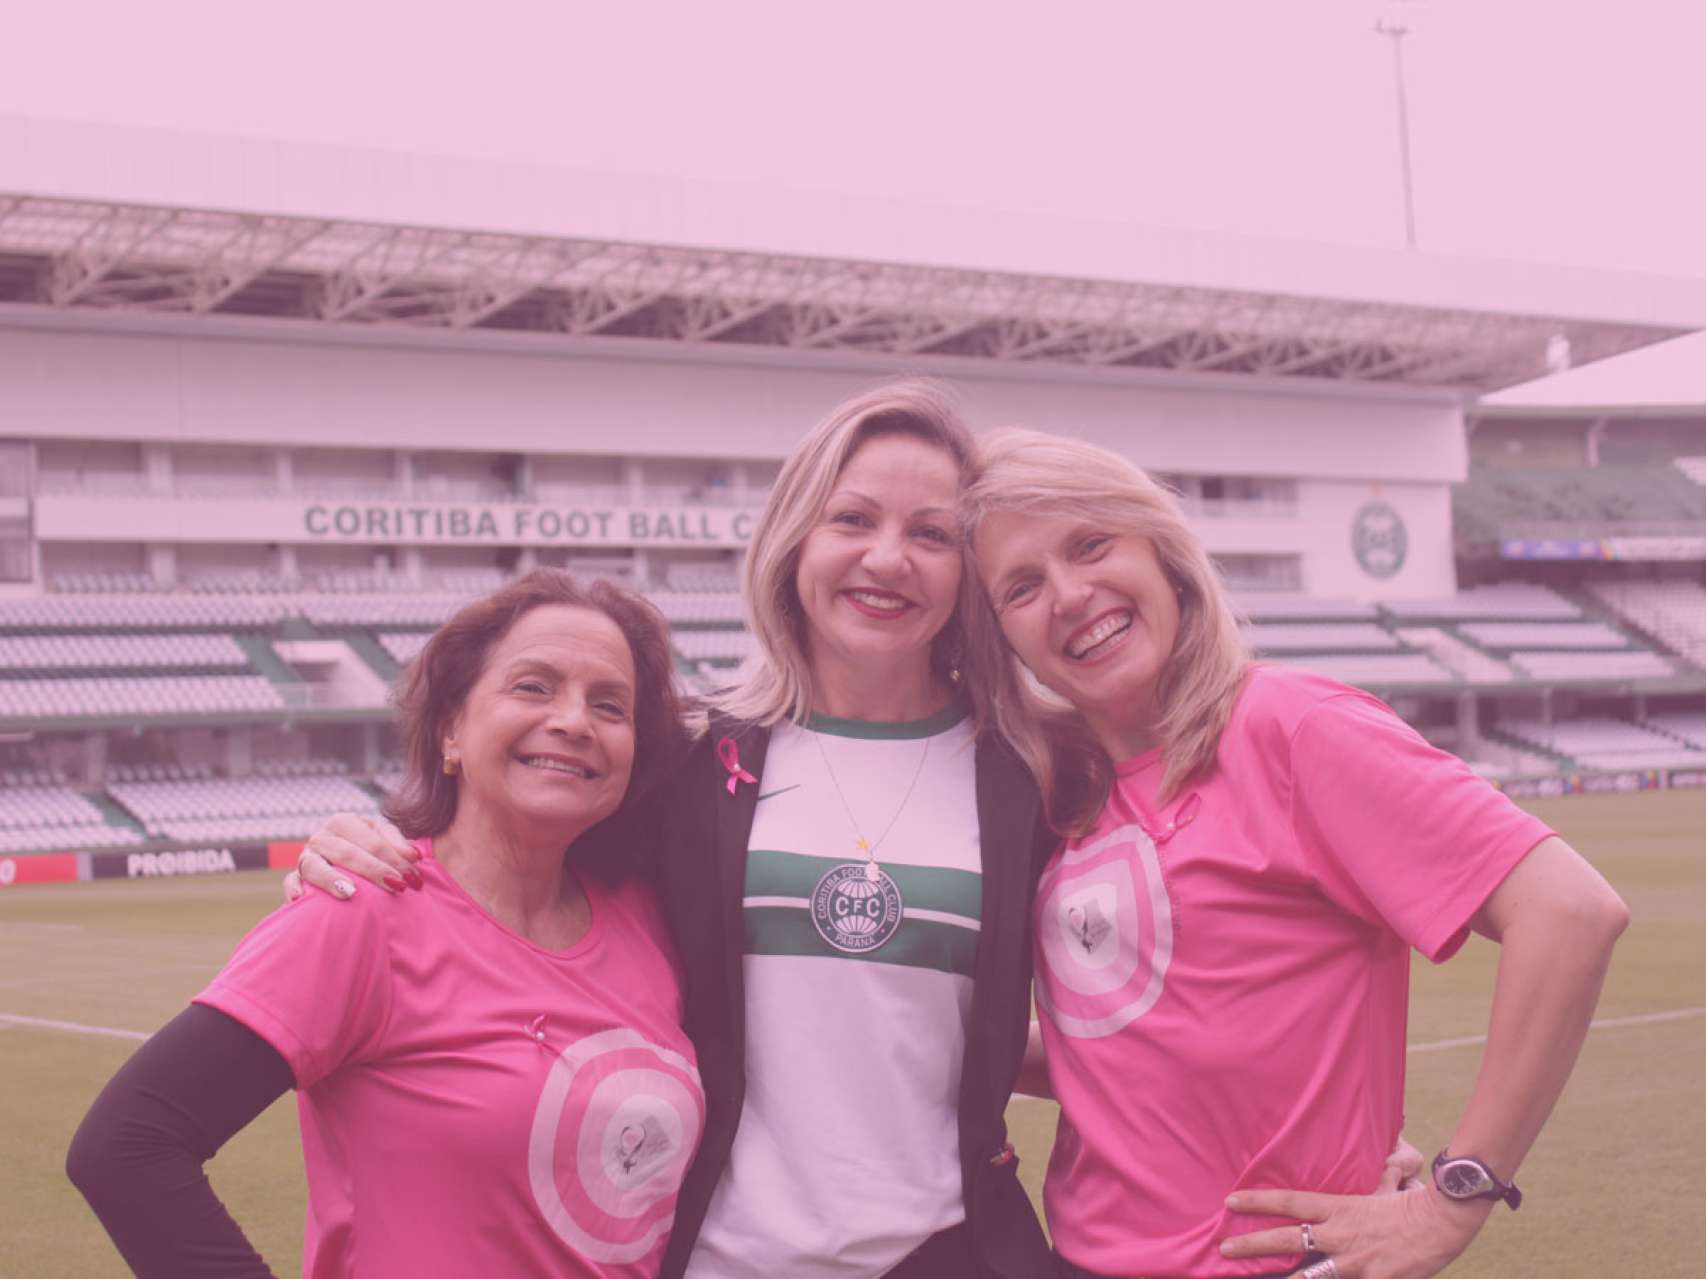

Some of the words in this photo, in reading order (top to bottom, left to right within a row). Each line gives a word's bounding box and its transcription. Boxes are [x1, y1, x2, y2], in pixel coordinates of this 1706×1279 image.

[304, 505, 498, 537] CORITIBA
[514, 509, 613, 539] FOOT
[629, 512, 718, 540] BALL
[127, 848, 236, 877] PROIBIDA
[817, 874, 841, 919] CORITIBA
[841, 867, 867, 879] FOO
[835, 896, 880, 917] CFC
